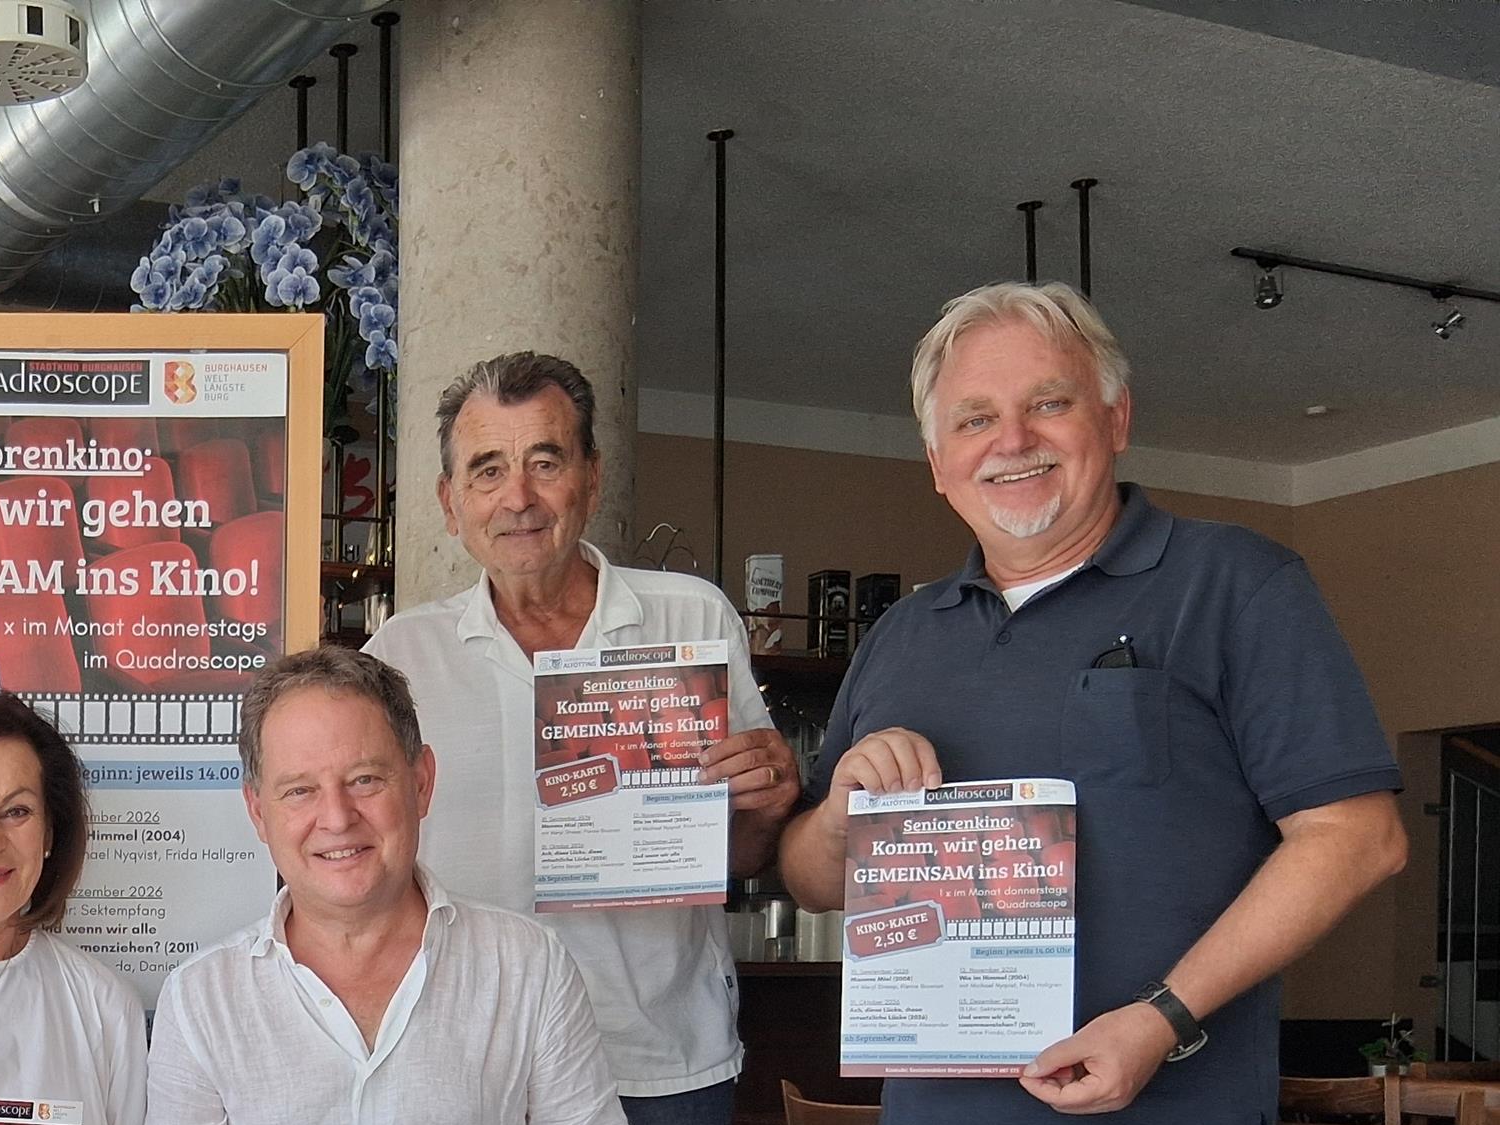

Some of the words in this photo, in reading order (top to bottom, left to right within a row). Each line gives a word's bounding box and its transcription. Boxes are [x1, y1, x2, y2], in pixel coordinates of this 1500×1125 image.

[204, 363, 269, 373] BURGHAUSEN
[204, 374, 230, 383] WELT
[204, 392, 230, 402] BURG
[82, 490, 212, 538] gehen
[75, 558, 139, 596] ins
[150, 559, 259, 597] Kino!
[4, 621, 15, 635] x
[22, 617, 47, 636] im
[54, 617, 124, 637] Monat
[131, 616, 267, 643] donnerstags
[83, 650, 108, 669] im
[115, 649, 266, 674] Quadroscope
[583, 676, 677, 694] Seniorenkino:
[556, 699, 614, 715] Komm,
[618, 697, 645, 710] wir
[651, 695, 700, 711] gehen
[541, 721, 644, 740] GEMEINSAM
[648, 719, 673, 734] ins
[677, 717, 719, 732] Kino!
[82, 766, 133, 784] eginn:
[135, 766, 194, 784] jeweils
[198, 766, 240, 781] 14.00
[545, 765, 606, 786] KINO-KARTE
[560, 783, 588, 798] 2,50
[589, 779, 597, 791] €
[86, 810, 122, 823] mber
[126, 811, 160, 824] 2026
[903, 816, 1014, 834] Seniorenkino:
[87, 829, 137, 841] Himmel
[141, 829, 186, 844] (2004)
[872, 840, 938, 857] Komm,
[943, 839, 977, 853] wir
[981, 836, 1042, 857] gehen
[113, 848, 162, 863] Nyqvist,
[165, 848, 198, 860] Frida
[202, 849, 255, 864] Hallgren
[853, 864, 974, 884] GEMEINSAM
[978, 863, 1008, 880] ins
[1012, 862, 1064, 878] Kino!
[69, 885, 125, 898] ezember
[129, 886, 163, 898] 2026
[81, 904, 166, 919] Sektempfang
[66, 924, 102, 935] wenn
[106, 923, 128, 935] wir
[131, 923, 157, 935] alle
[856, 913, 928, 935] KINO-KARTE
[874, 932, 905, 949] 2,50
[907, 928, 918, 941] €
[77, 941, 161, 953] menziehen?
[164, 941, 199, 956] (2011)
